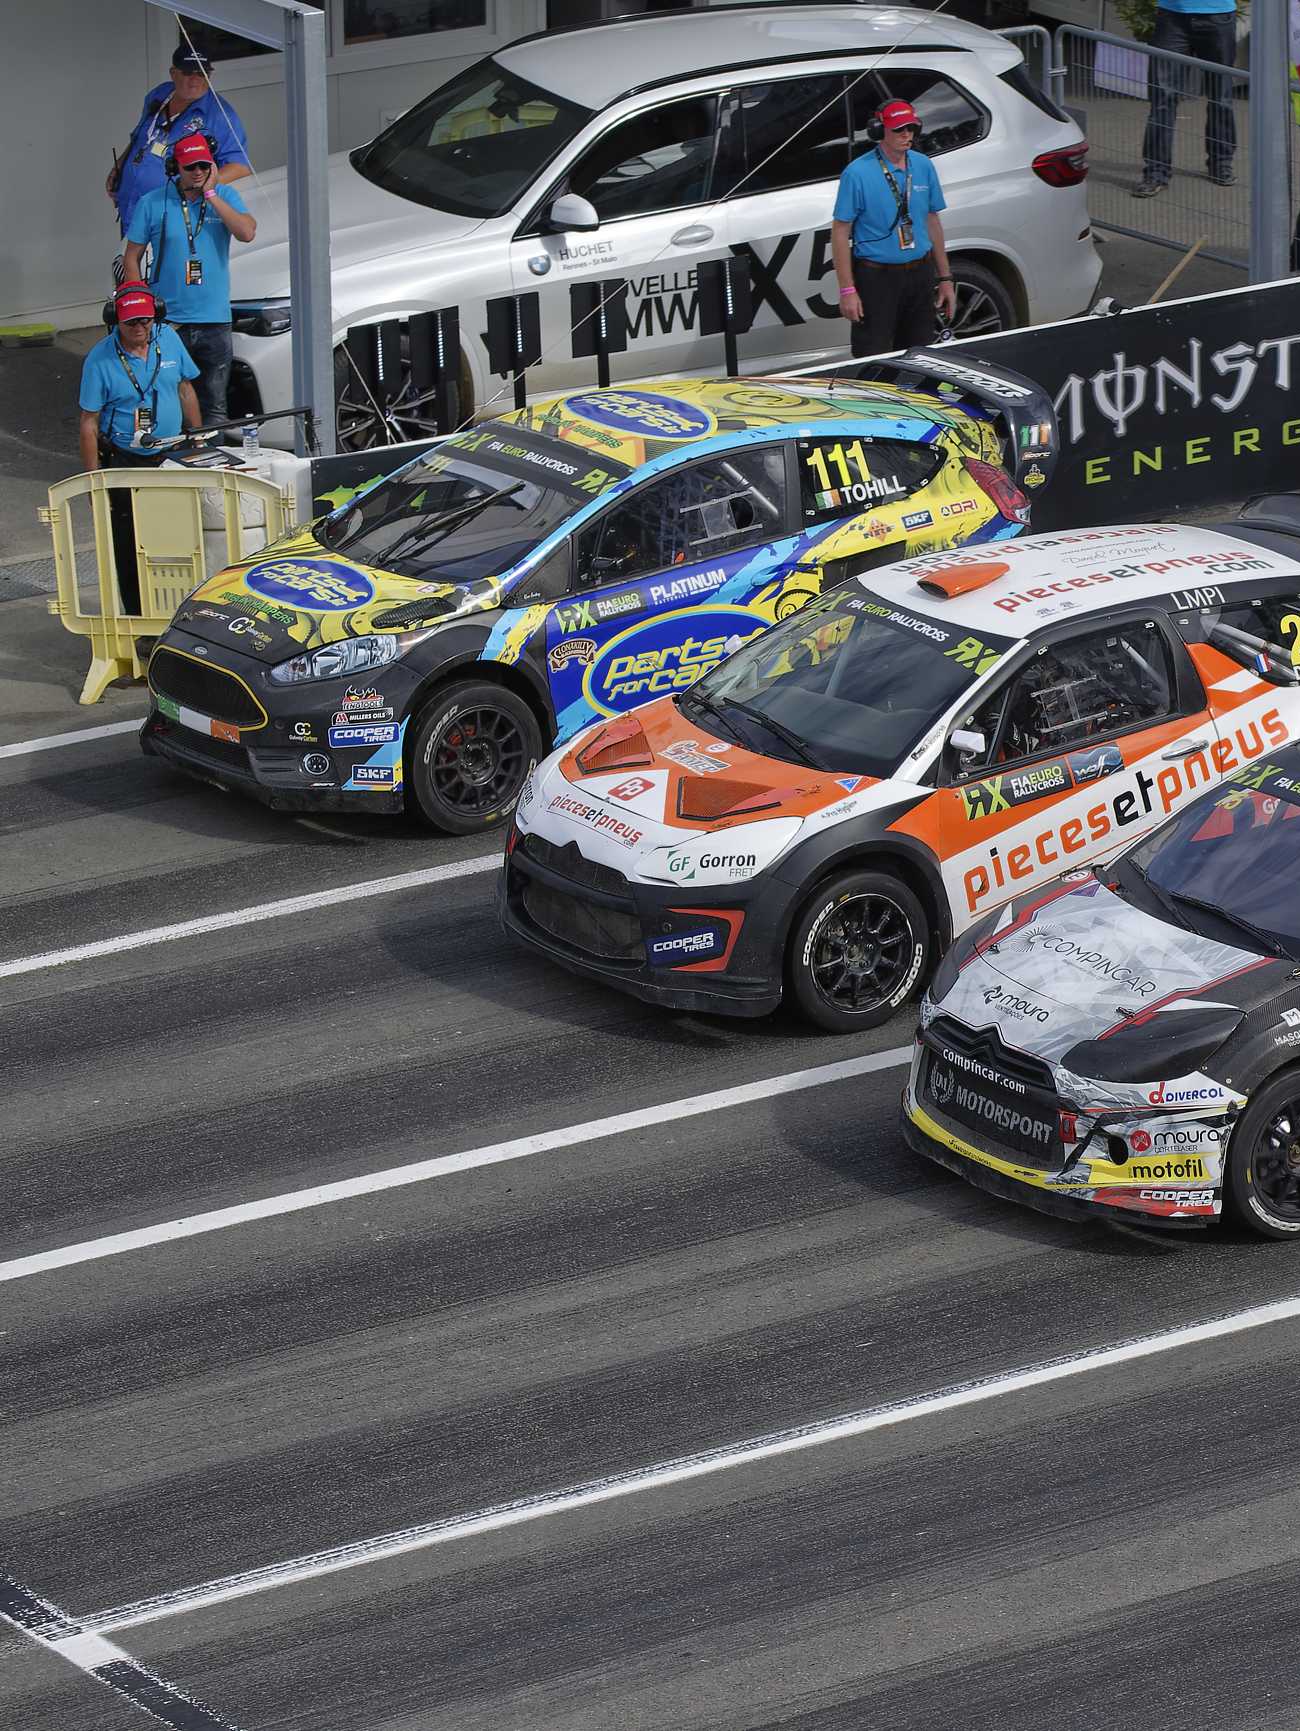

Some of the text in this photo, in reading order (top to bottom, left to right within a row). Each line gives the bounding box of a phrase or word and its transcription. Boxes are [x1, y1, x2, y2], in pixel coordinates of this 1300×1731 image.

[559, 240, 613, 261] HUCHET
[728, 229, 853, 327] X5
[625, 289, 700, 340] MW
[487, 441, 501, 451] FIA
[500, 444, 528, 458] EURO
[524, 451, 579, 476] RALLYCROSS
[806, 440, 871, 490] 111
[839, 476, 907, 504] TOHILL
[903, 512, 929, 527] SKF
[1203, 559, 1275, 576] .com
[650, 568, 727, 601] PLATINUM
[993, 549, 1255, 614] piecesetpneus
[599, 601, 641, 617] RALLYCROSS
[1170, 586, 1226, 611] LMPI
[847, 599, 1003, 677] FIA EURO RALLYCROSS RX
[602, 635, 726, 690] parts
[607, 659, 722, 702] for car
[333, 726, 395, 739] COOPER
[363, 735, 394, 743] TIRES
[424, 704, 459, 765] COOPER
[356, 768, 391, 779] SKF
[1273, 776, 1294, 790] FIA
[960, 775, 1012, 821] RX
[1013, 776, 1065, 799] RALLYCROSS
[963, 708, 1290, 912] piecesetpneus
[668, 856, 691, 873] GF
[699, 853, 756, 870] Gorron
[729, 868, 756, 877] FRET
[653, 932, 714, 954] COOPER
[803, 901, 834, 966] COOPER
[682, 941, 714, 954] TIRES
[890, 943, 923, 1007] COOPER
[1043, 936, 1157, 997] COMPINCAR
[1000, 993, 1050, 1023] moura
[943, 1048, 1026, 1094] compincar.com
[1165, 1087, 1225, 1103] DIVERCOL
[955, 1085, 1053, 1143] MOTORSPORT
[1153, 1129, 1220, 1146] moura
[1132, 1158, 1203, 1179] motofil
[1140, 1189, 1215, 1201] COOPER
[1175, 1199, 1214, 1208] TIRES
